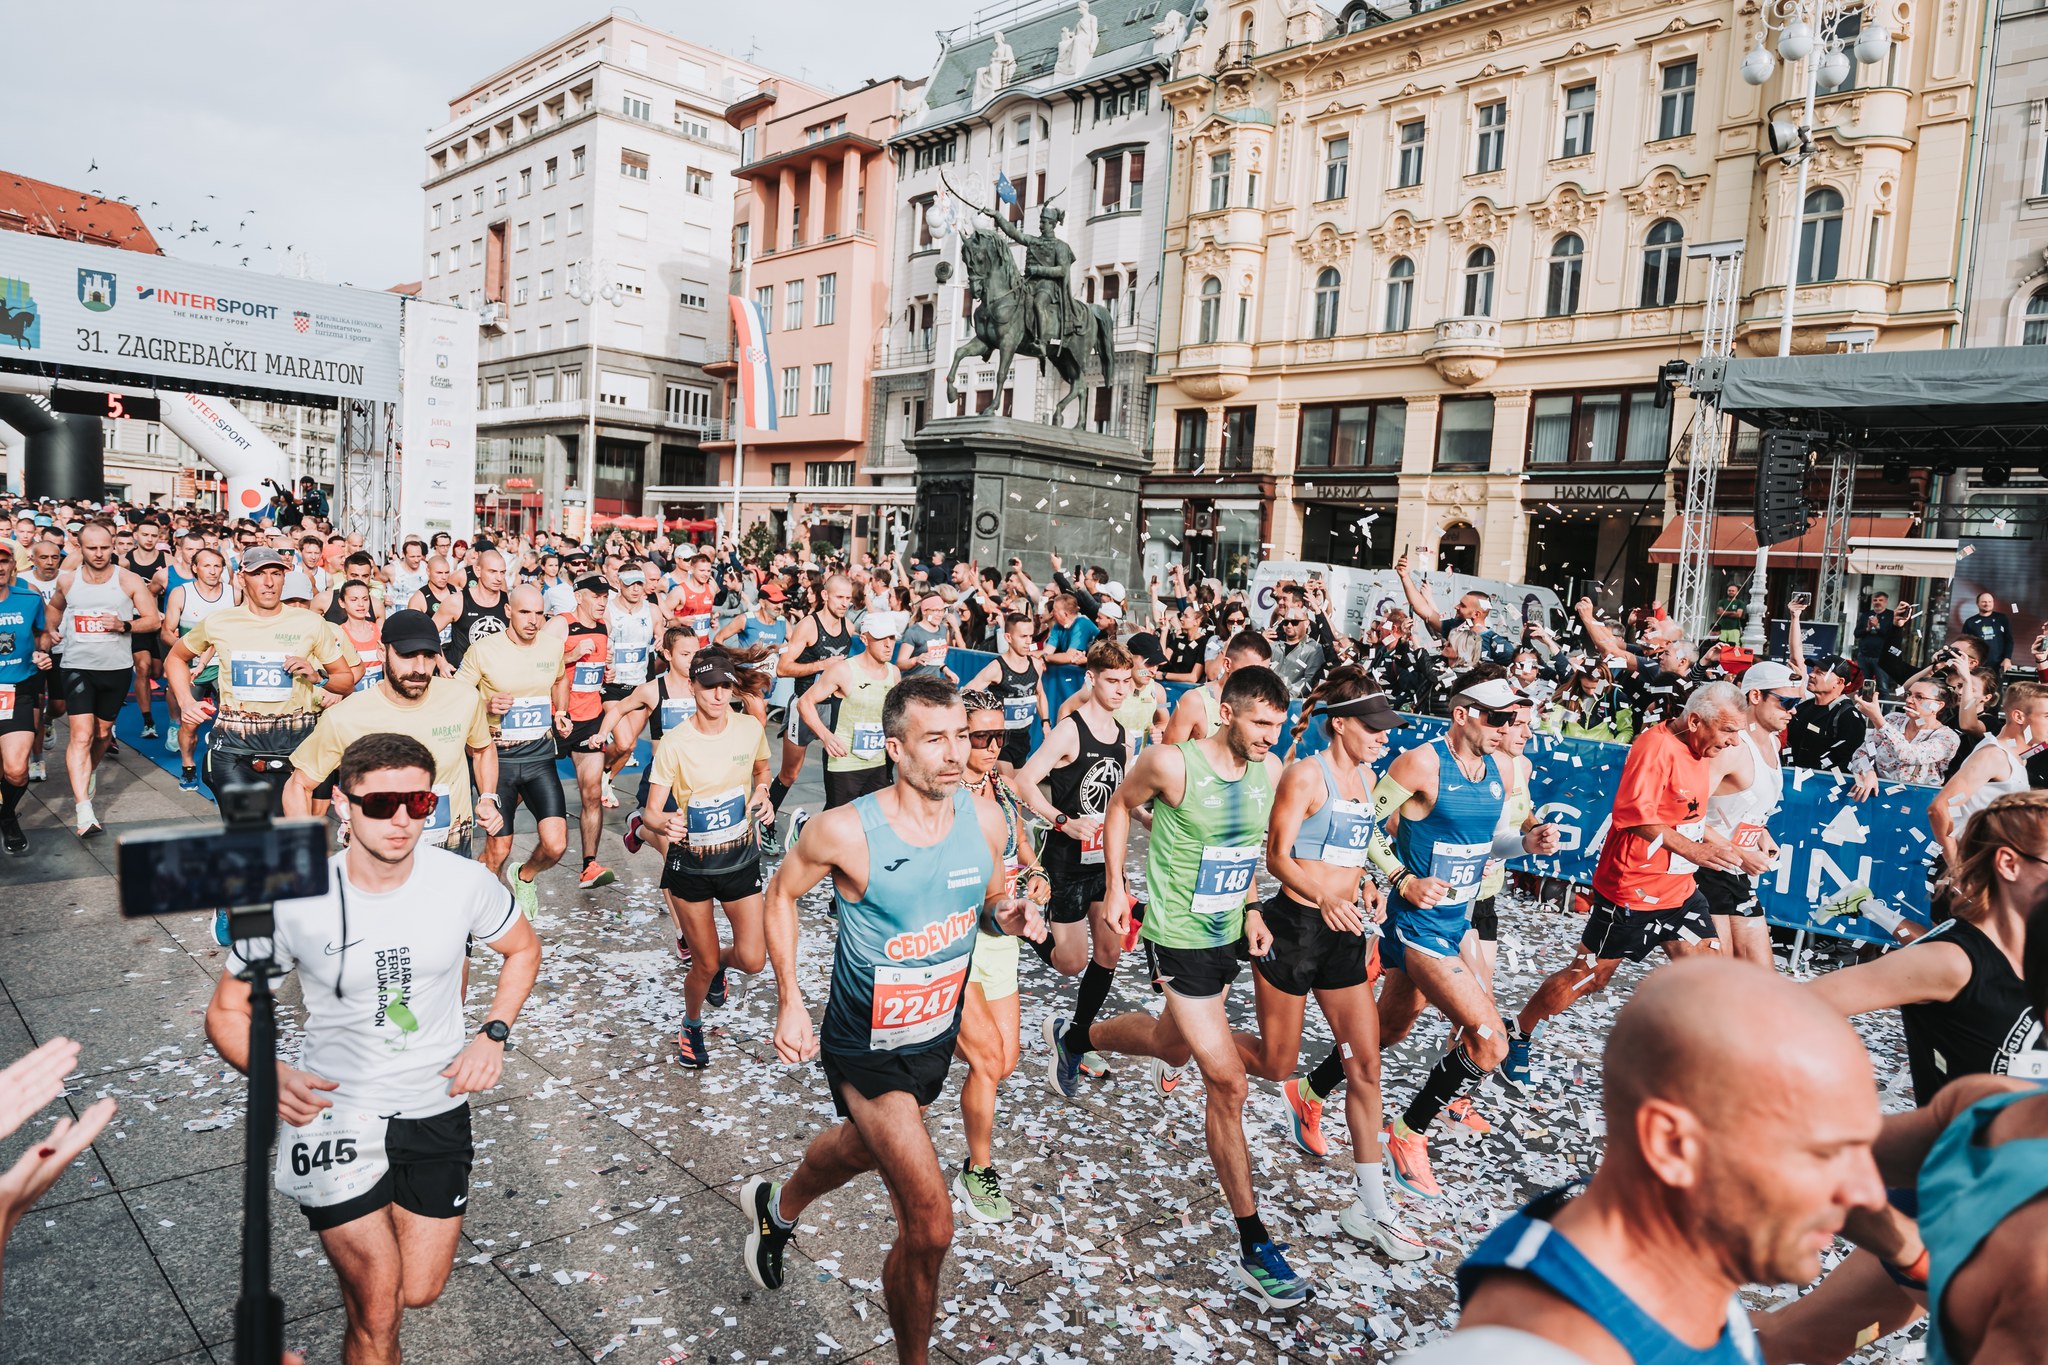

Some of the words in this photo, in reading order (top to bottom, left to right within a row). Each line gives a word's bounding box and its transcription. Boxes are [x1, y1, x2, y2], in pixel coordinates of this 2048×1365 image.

[157, 288, 279, 320] INTERSPORT
[173, 310, 186, 318] THE
[189, 312, 214, 321] HEART
[226, 318, 249, 327] SPORT
[315, 313, 350, 325] REPUBLIKA
[351, 319, 383, 330] HRVATSKA
[315, 321, 362, 334] Ministarstvo
[315, 329, 343, 340] turizma
[349, 334, 372, 343] sporta
[77, 327, 108, 354] 31.
[117, 333, 257, 372] ZAGREBAČKI
[265, 353, 364, 386] MARATON
[185, 392, 253, 452] INTERSPORT
[1317, 486, 1374, 498] HARMICA
[1554, 485, 1630, 499] HARMICA
[625, 652, 639, 662] 99
[243, 668, 281, 686] 126
[584, 672, 599, 684] 80
[512, 711, 543, 727] 122
[1014, 708, 1028, 720] 63
[862, 735, 886, 748] 154
[705, 809, 731, 830] 25
[1348, 824, 1370, 847] 32
[1214, 868, 1250, 893] 148
[1449, 865, 1475, 886] 56
[886, 907, 977, 960] CEDEVITA
[882, 982, 958, 1026] 2247
[2006, 1015, 2034, 1056] ATLETS
[291, 1138, 358, 1177] 645
